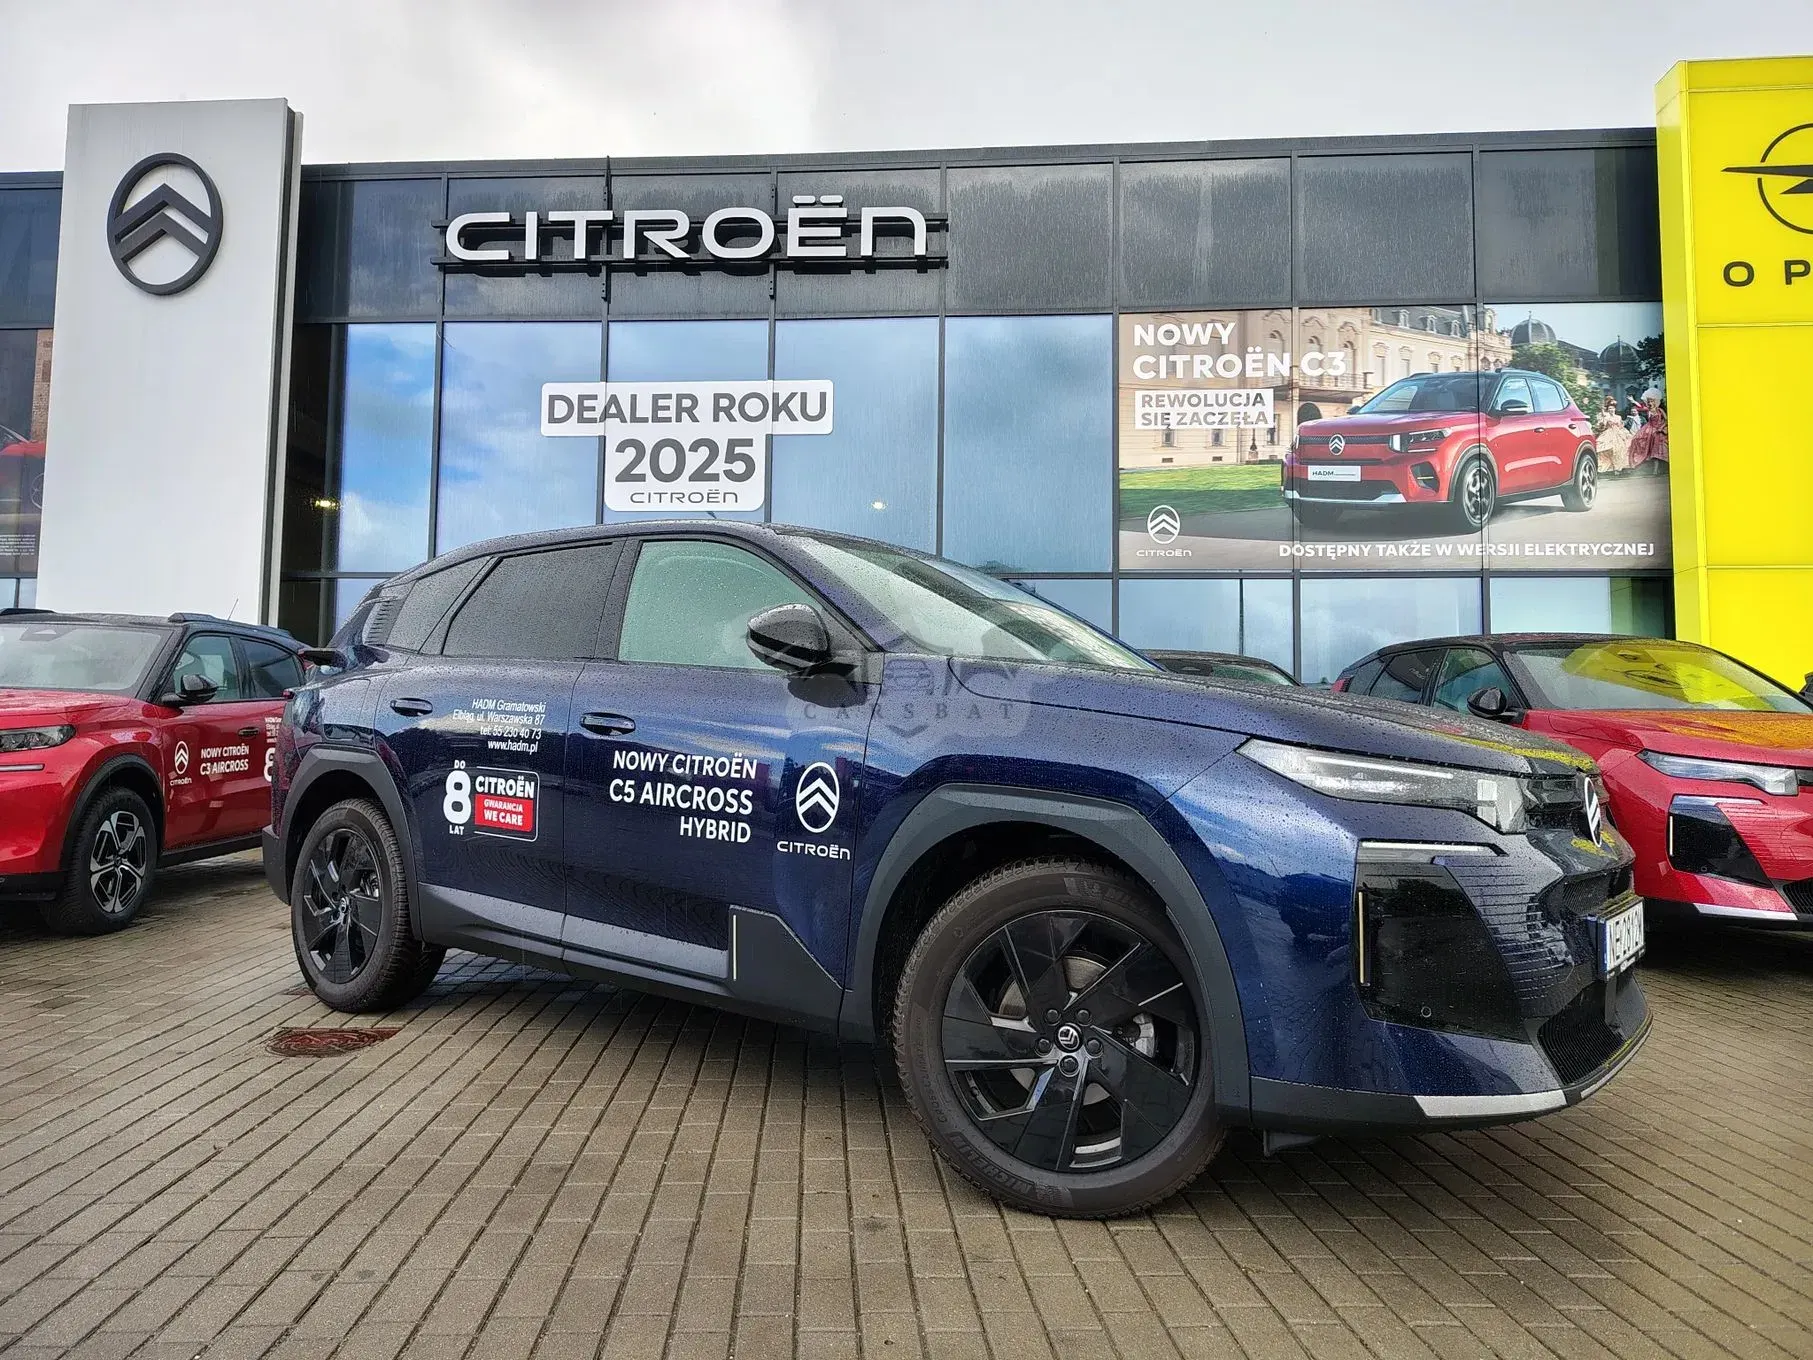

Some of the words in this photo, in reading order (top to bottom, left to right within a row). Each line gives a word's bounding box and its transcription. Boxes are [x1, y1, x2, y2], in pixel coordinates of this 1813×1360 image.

[445, 195, 927, 260] CITROËN
[1133, 322, 1236, 346] NOWY
[1132, 346, 1290, 380] CITROËN
[1301, 350, 1346, 377] C3
[547, 393, 699, 424] DEALER
[713, 391, 828, 423] ROKU
[1141, 392, 1266, 408] REWOLUCJA
[1141, 412, 1171, 430] SIĘ
[1177, 411, 1268, 429] ZACZĘŁA
[614, 438, 756, 483] 2025
[629, 489, 738, 504] CITROËN
[1136, 548, 1192, 557] CITROËN
[1279, 544, 1371, 560] DOSTĘPNY
[1374, 541, 1431, 557] TAKŻE
[1435, 544, 1453, 556] W
[1457, 543, 1520, 556] WERSJI
[1524, 543, 1655, 556] ELEKTRYCZNEJ
[472, 698, 496, 710] HADM
[496, 699, 547, 713] Gramatowski
[487, 711, 533, 725] Warszawska
[534, 714, 546, 726] 87
[519, 727, 530, 739] 40
[531, 728, 542, 740] 73
[200, 747, 222, 759] NOWY
[222, 743, 250, 757] CITROËN
[487, 739, 539, 755] www.hadm.pl
[200, 762, 211, 776] C3
[211, 759, 249, 774] AIRCROSS
[454, 759, 466, 770] DO
[612, 750, 669, 773] NOWY
[672, 751, 758, 779] CITROËN
[475, 775, 535, 799] CITROËN
[443, 770, 472, 825] 8
[609, 778, 636, 803] C5
[639, 781, 754, 816] AIRCROSS
[484, 809, 498, 822] WE
[499, 812, 524, 826] CARE
[449, 825, 465, 836] LAT
[679, 815, 751, 844] HYBRID
[776, 840, 851, 861] CITROËN
